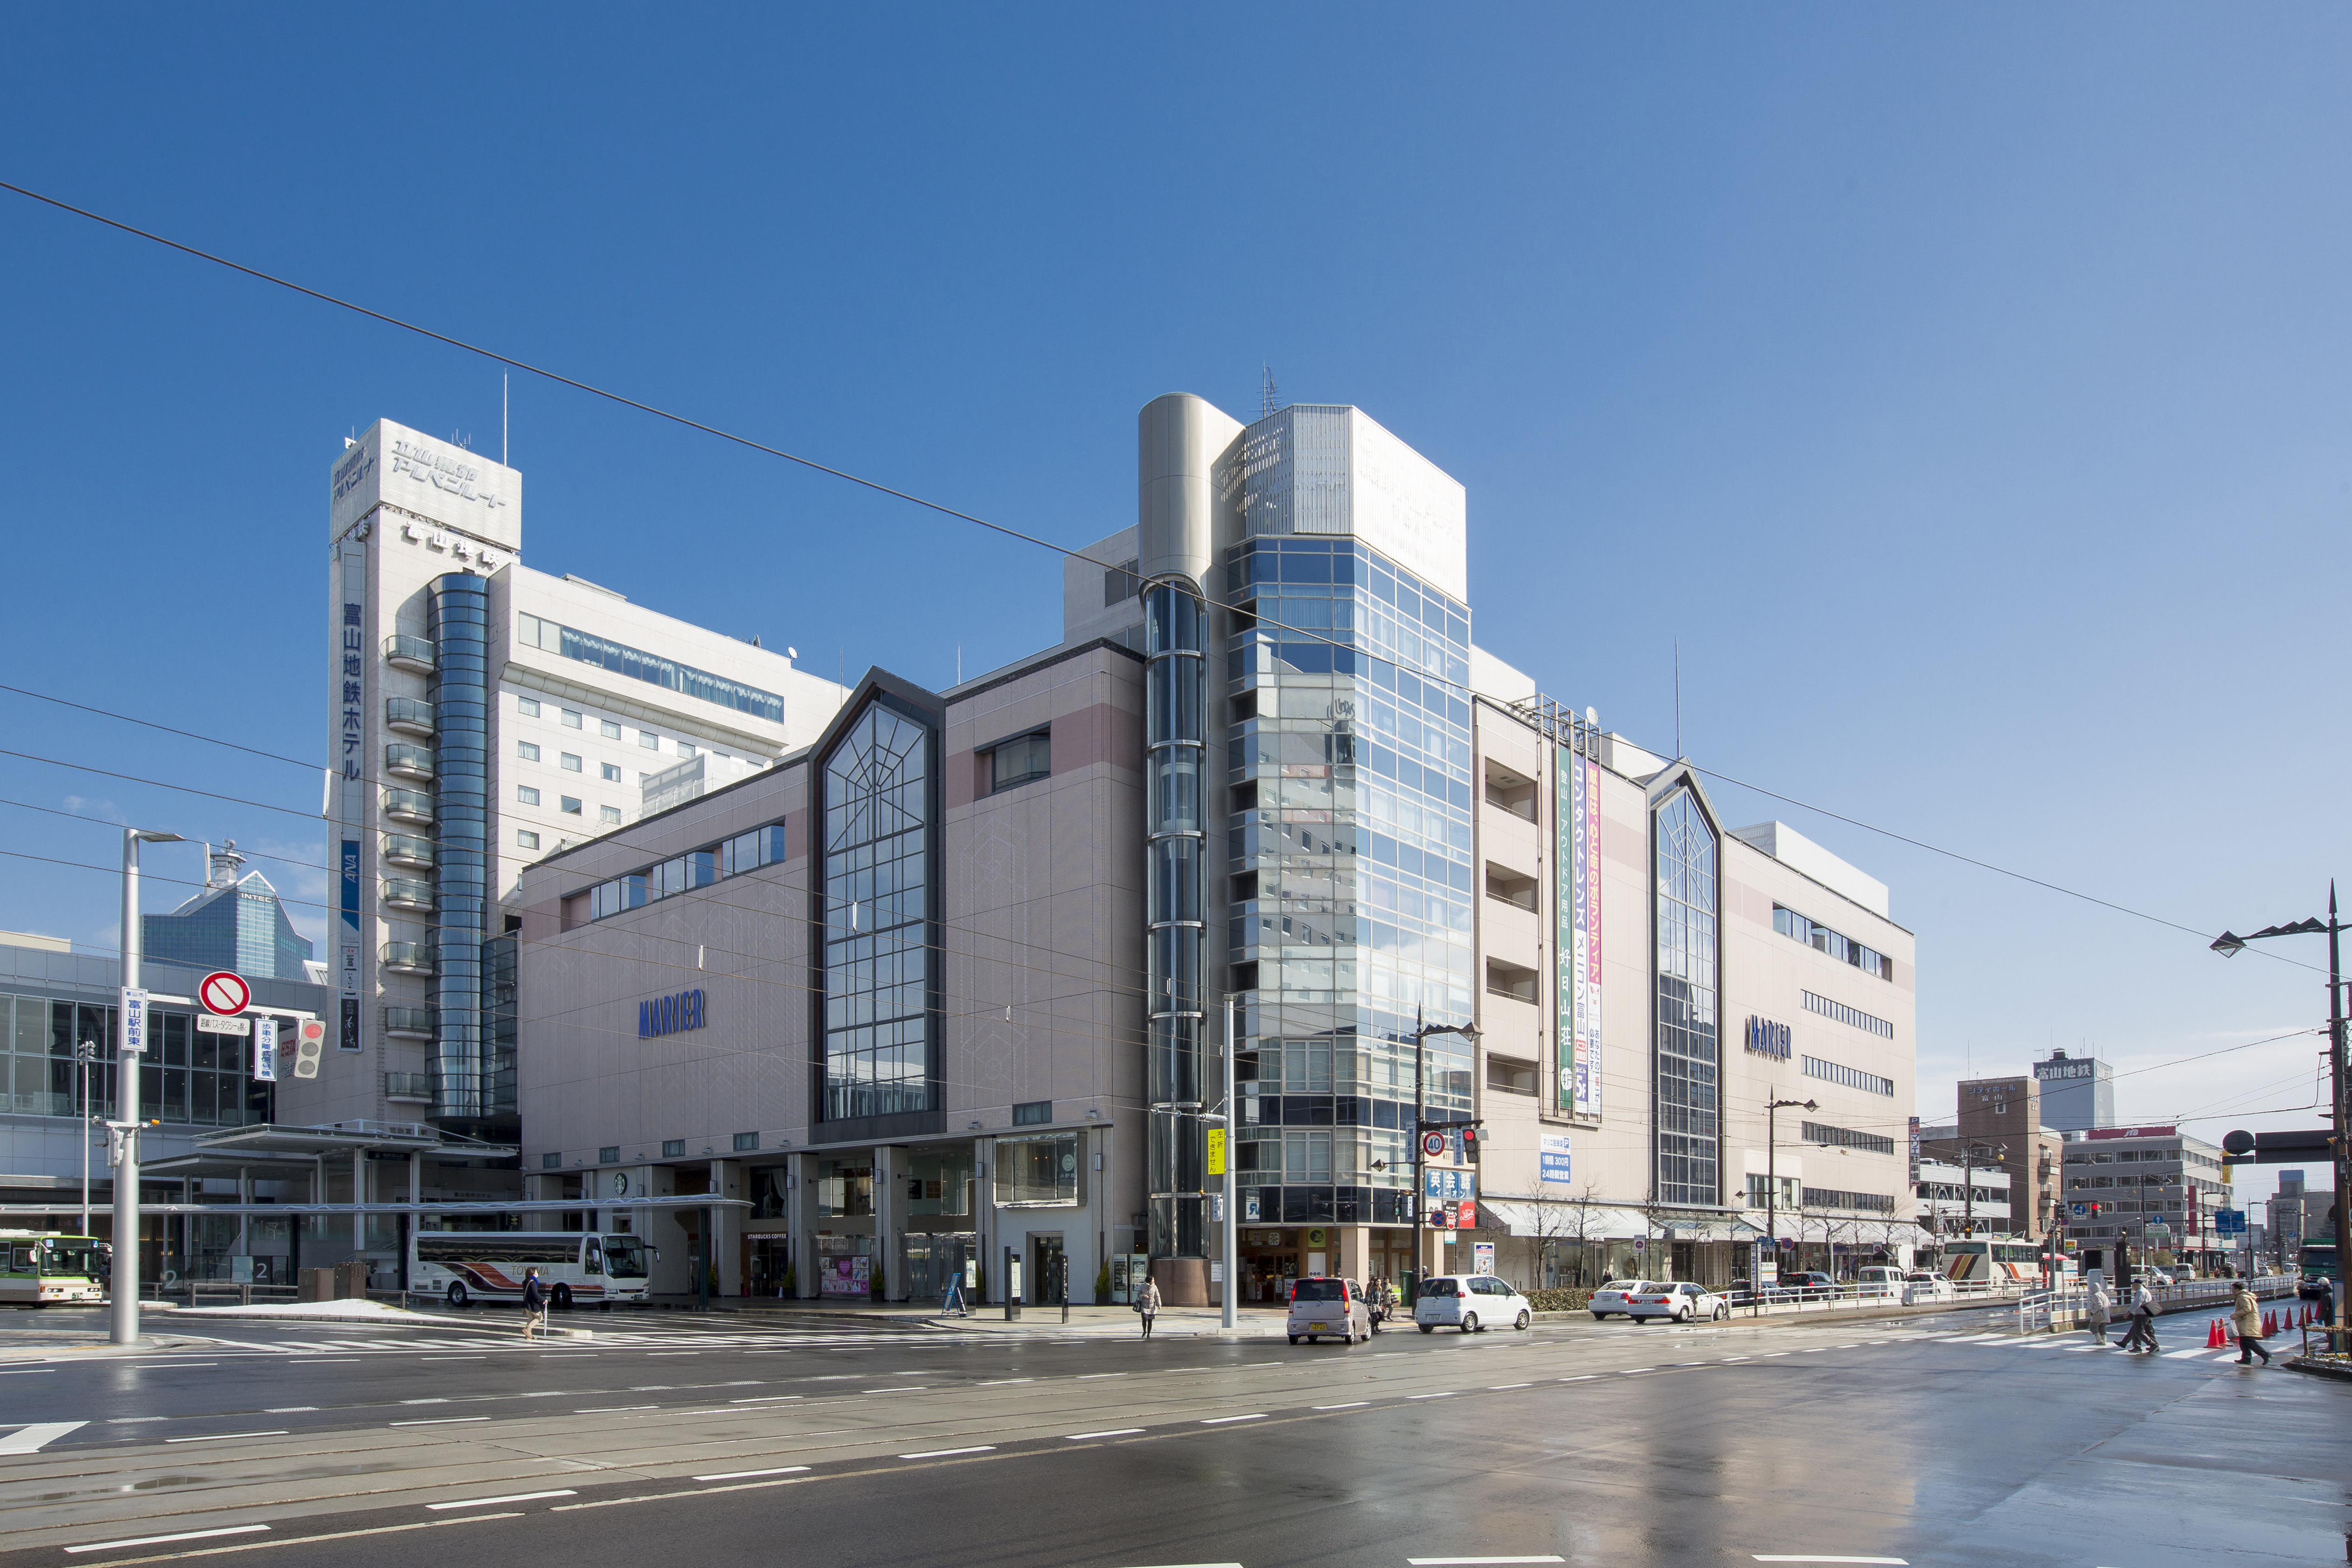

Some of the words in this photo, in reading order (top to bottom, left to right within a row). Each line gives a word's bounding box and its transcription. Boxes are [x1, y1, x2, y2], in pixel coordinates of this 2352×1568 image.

[392, 439, 480, 481] 立山黒部
[392, 455, 508, 508] アルペンルート
[406, 520, 502, 569] 富山地鉄
[343, 603, 361, 782] 富山地鉄ホテル
[1560, 769, 1569, 929] 登山・アウトドア用品
[1574, 765, 1585, 926] コンタクトレンズ
[345, 855, 356, 883] ANA
[1589, 767, 1600, 983] 献血は、心と命のボランティア。
[1559, 947, 1571, 1046] 好日山荘
[127, 1000, 141, 1046] 富山駅前東
[638, 989, 704, 1040] MARIER
[201, 1018, 247, 1032] 路線バス・タクシーを除く
[1749, 1014, 1792, 1060] MARIER
[261, 1023, 272, 1077] 歩車分離式信号機
[2037, 1064, 2091, 1080] 富山地鉄
[1576, 1074, 1586, 1099] 5F
[1968, 1084, 2016, 1094] シティホール
[1217, 1131, 1223, 1148] 左折
[2124, 1128, 2138, 1137] JTB
[1428, 1138, 1440, 1150] 40
[1543, 1139, 1563, 1148] マリエ駐車場
[1443, 1152, 1454, 1161] MARIE
[1542, 1155, 1554, 1165] 1時間
[1555, 1156, 1569, 1167] 300円
[1910, 1133, 1919, 1181] マリエ駐車場
[1431, 1171, 1471, 1190] 英会話
[1542, 1169, 1569, 1180] 24時間営業
[1436, 1188, 1466, 1198] イーオン
[1269, 1233, 1279, 1244] 茶
[164, 1270, 177, 1289] 2
[256, 1263, 267, 1278] 2
[511, 1266, 549, 1276] TOYMA
